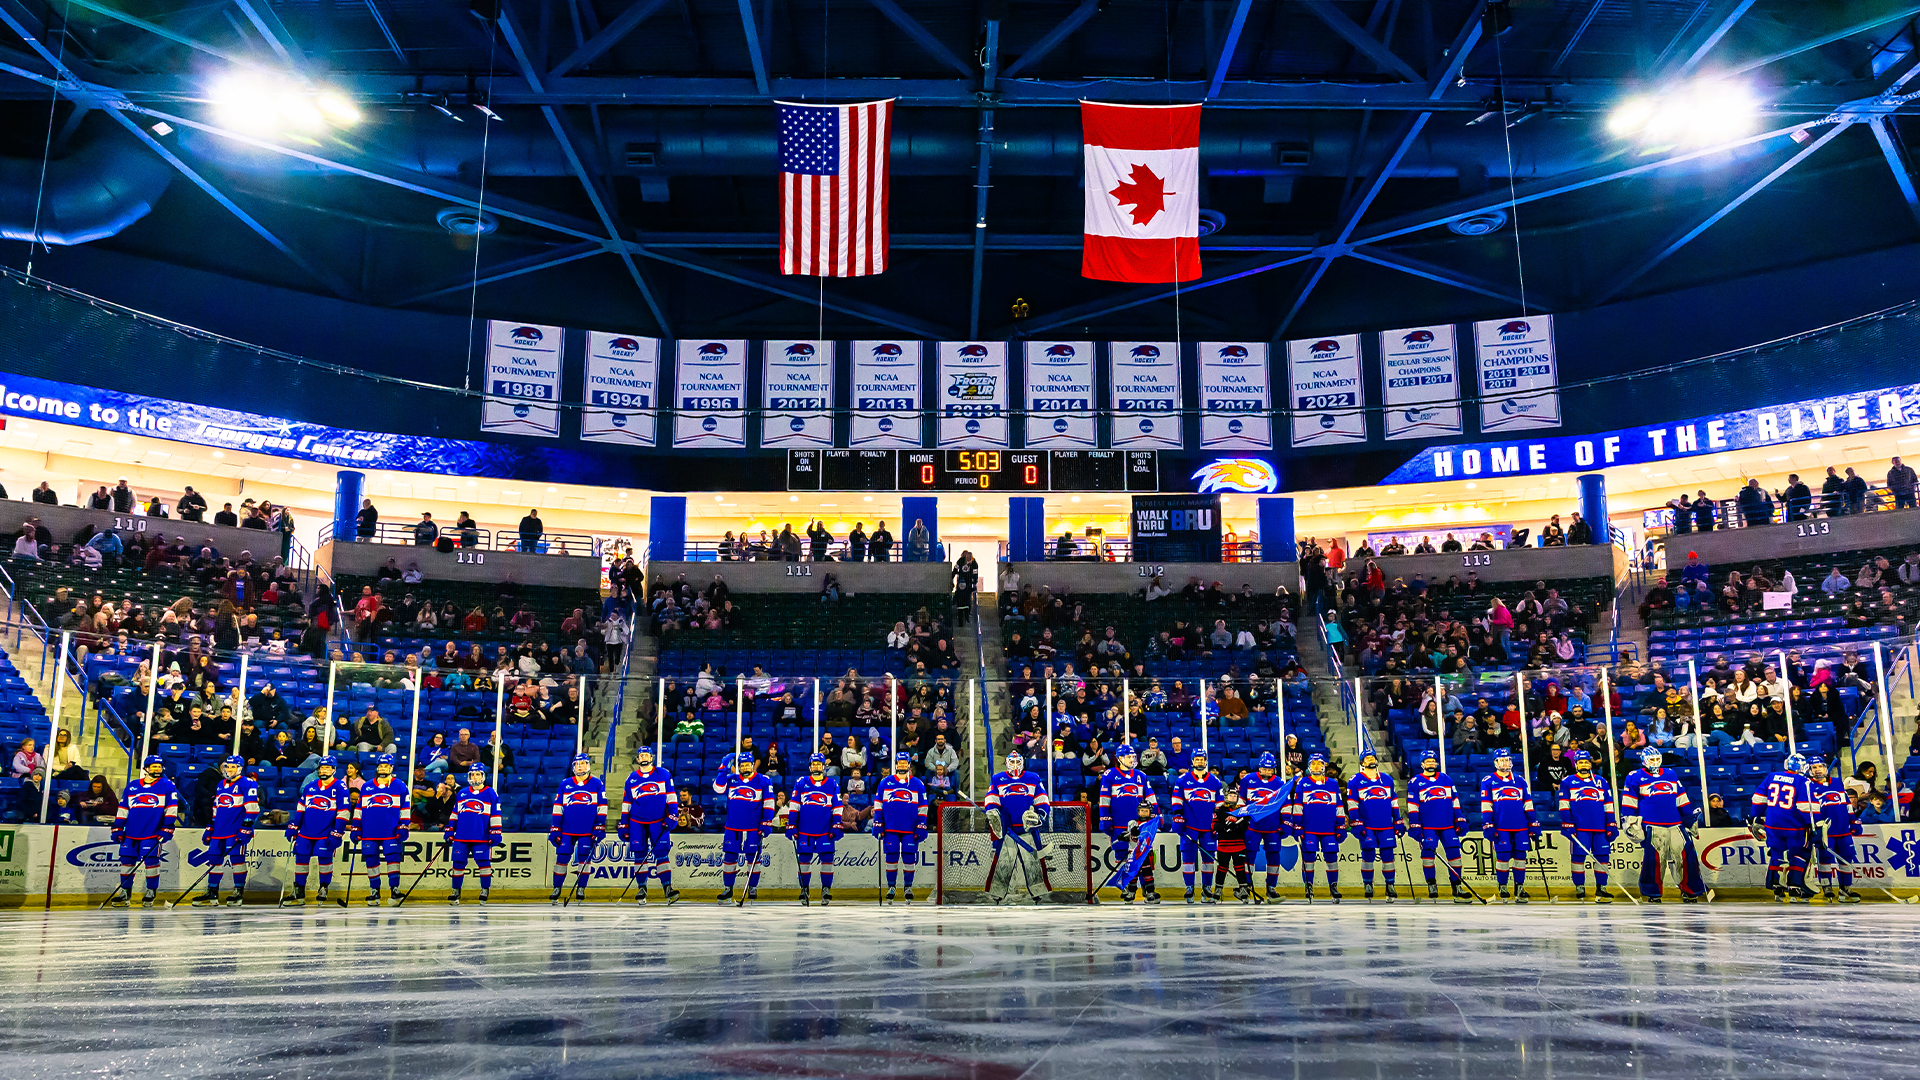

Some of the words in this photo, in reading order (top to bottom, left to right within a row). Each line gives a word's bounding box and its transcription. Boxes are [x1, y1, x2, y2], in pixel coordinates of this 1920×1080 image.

[1496, 347, 1534, 356] PLAYOFF
[511, 356, 537, 366] NCAA
[1388, 358, 1420, 367] REGULAR
[1423, 355, 1451, 364] SEASON
[1484, 354, 1549, 367] CHAMPIONS
[491, 365, 556, 379] TOURNAMENT
[610, 366, 635, 376] NCAA
[1313, 370, 1338, 378] NCAA
[1398, 366, 1441, 375] CHAMPIONS
[1488, 370, 1512, 378] 2013
[1522, 366, 1546, 375] 2014
[590, 376, 653, 389] TOURNAMENT
[956, 376, 997, 386] FROZEN
[1294, 378, 1358, 390] TOURNAMENT
[1392, 378, 1416, 386] 2013
[1425, 375, 1448, 384] 2017
[501, 382, 546, 398] 1988
[600, 392, 642, 407] 1994
[690, 399, 732, 409] 1996
[778, 399, 820, 408] 2012
[866, 399, 907, 409] 2013
[1040, 400, 1082, 410] 2014
[1126, 400, 1167, 409] 2016
[1215, 400, 1256, 409] 2017
[1306, 394, 1349, 409] 2022
[952, 405, 993, 416] 2013
[89, 403, 120, 424] to
[127, 408, 172, 432] the
[195, 421, 296, 450] Tsongas
[297, 435, 382, 460] Center
[1434, 444, 1546, 477] HOME
[1575, 436, 1620, 466] OF
[1648, 420, 1726, 456] THE
[1758, 394, 1903, 440] RIVER
[910, 455, 933, 463] HOME
[960, 452, 1000, 470] 5:03
[1012, 455, 1038, 463] GUEST
[922, 465, 933, 484] 0
[1025, 465, 1036, 484] 0
[980, 475, 989, 488] 0
[1137, 510, 1168, 520] WALK
[114, 516, 146, 532] 110
[1137, 520, 1164, 530] THRU
[1796, 522, 1830, 538] 113
[456, 552, 484, 565] 110
[1462, 554, 1491, 568] 113
[786, 565, 812, 576] 111
[1139, 566, 1164, 577] 112
[1137, 775, 1142, 783] A
[1596, 780, 1602, 788] A
[232, 785, 238, 793] A
[331, 788, 336, 798] C
[1767, 783, 1795, 810] 33
[678, 841, 716, 850] Commercial
[342, 841, 532, 862] HRITGE
[810, 850, 878, 867] Mchelob
[4, 868, 24, 877] Bank
[424, 868, 531, 878] PROPETIES
[1853, 867, 1885, 878] EMS
